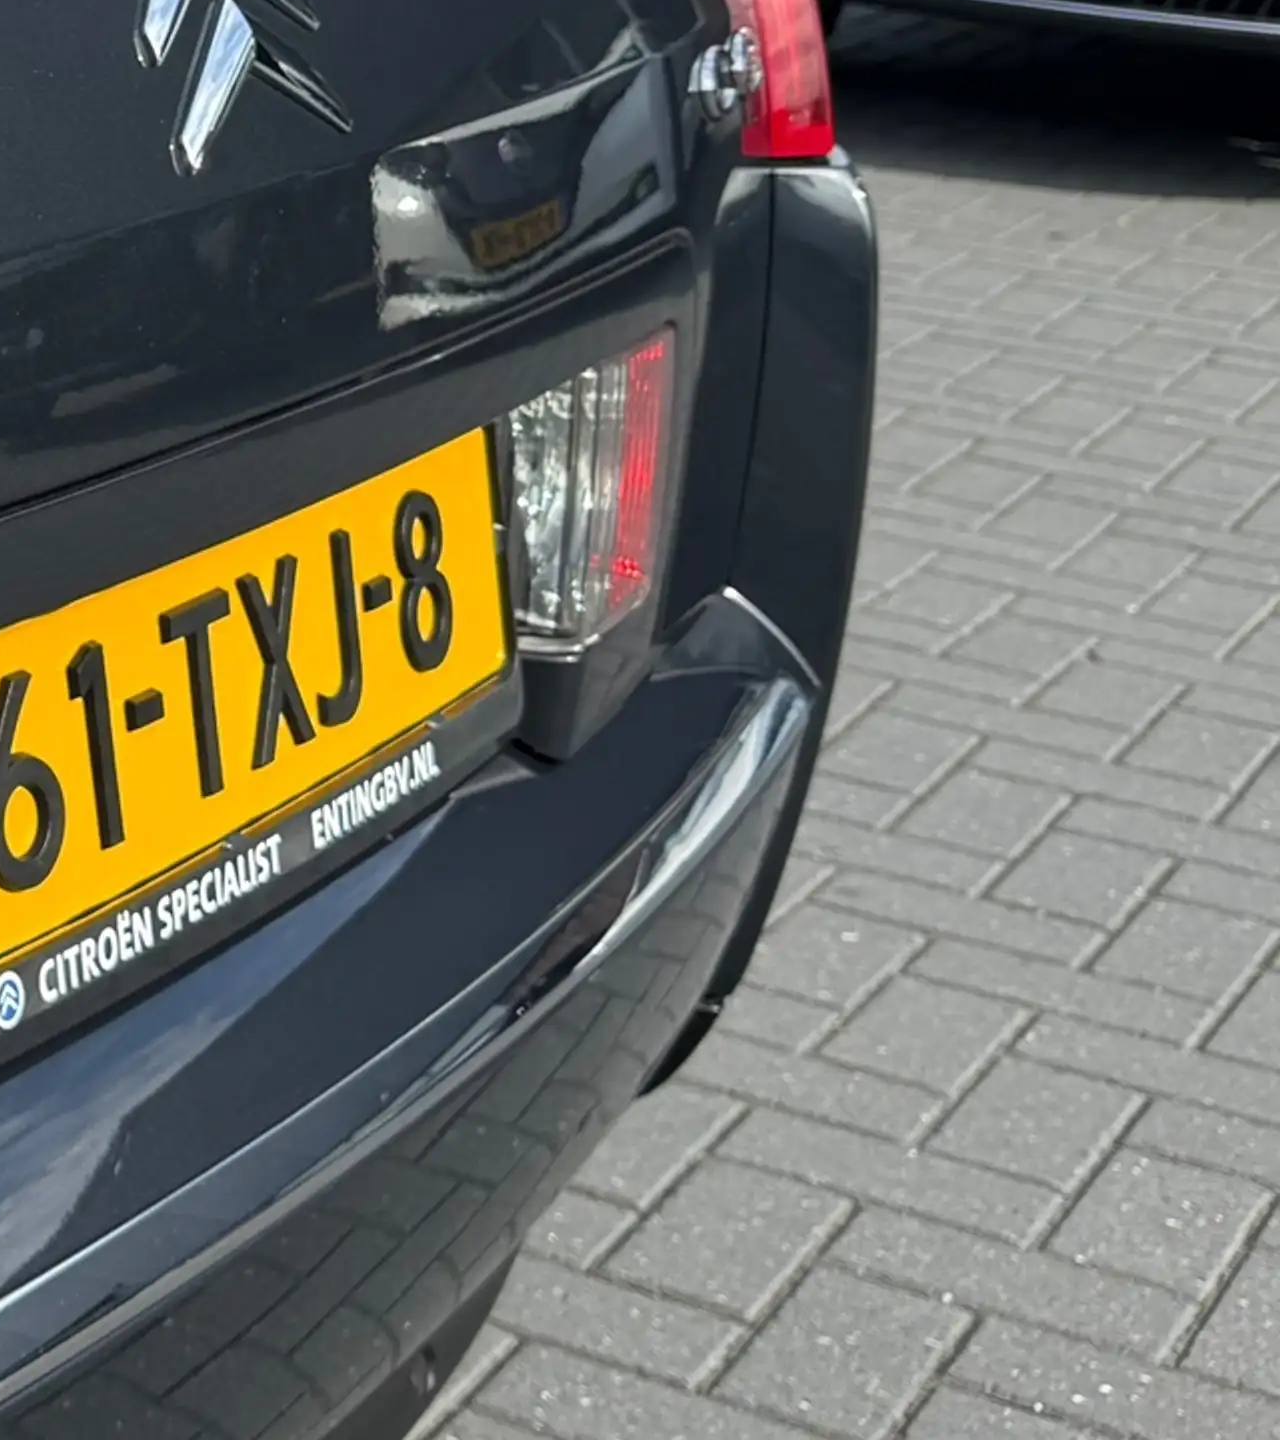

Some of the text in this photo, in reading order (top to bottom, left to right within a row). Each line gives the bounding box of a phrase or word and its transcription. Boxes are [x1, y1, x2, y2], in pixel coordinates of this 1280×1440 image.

[37, 740, 441, 1005] CITROËN SPECIALIST ENTINGBV.NL
